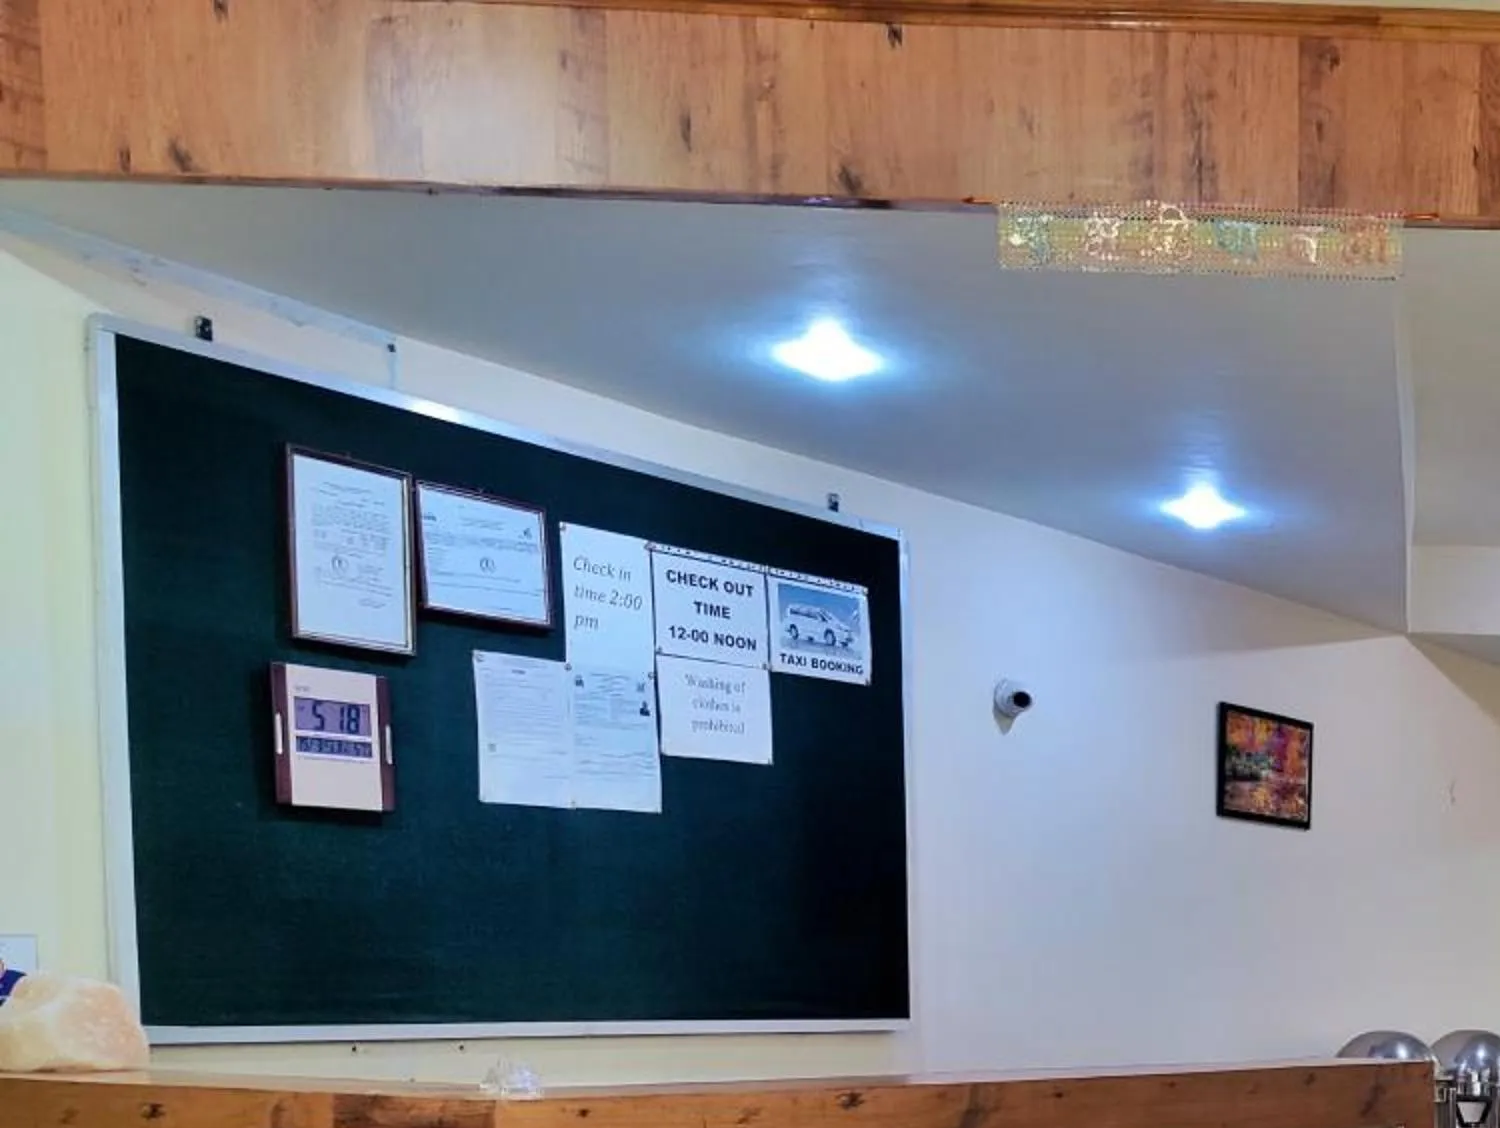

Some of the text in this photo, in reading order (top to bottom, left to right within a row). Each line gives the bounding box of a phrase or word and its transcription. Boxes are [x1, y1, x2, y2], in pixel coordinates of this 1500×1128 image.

[573, 556, 632, 582] Check in
[666, 569, 754, 597] CHECK OUT
[573, 585, 643, 611] time 2:00
[694, 601, 731, 619] TIME
[573, 615, 599, 631] pm
[669, 625, 757, 651] 12-00 NOON
[779, 652, 864, 675] TAXI BOOKING
